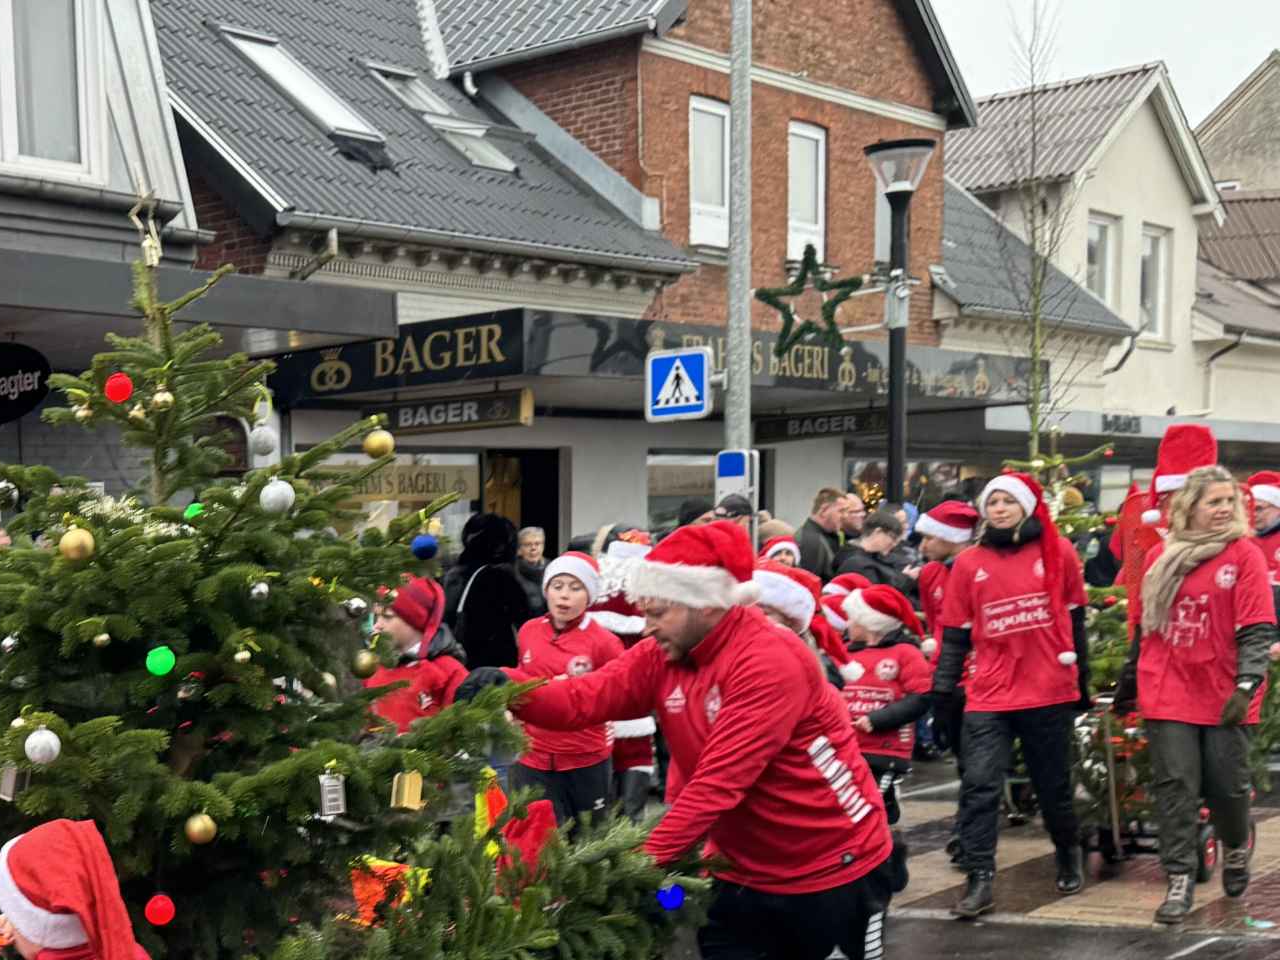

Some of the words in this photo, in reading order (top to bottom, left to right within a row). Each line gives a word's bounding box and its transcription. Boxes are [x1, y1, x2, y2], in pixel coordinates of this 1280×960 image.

[373, 323, 507, 378] BAGER
[399, 401, 480, 427] BAGER
[787, 415, 857, 435] BAGER
